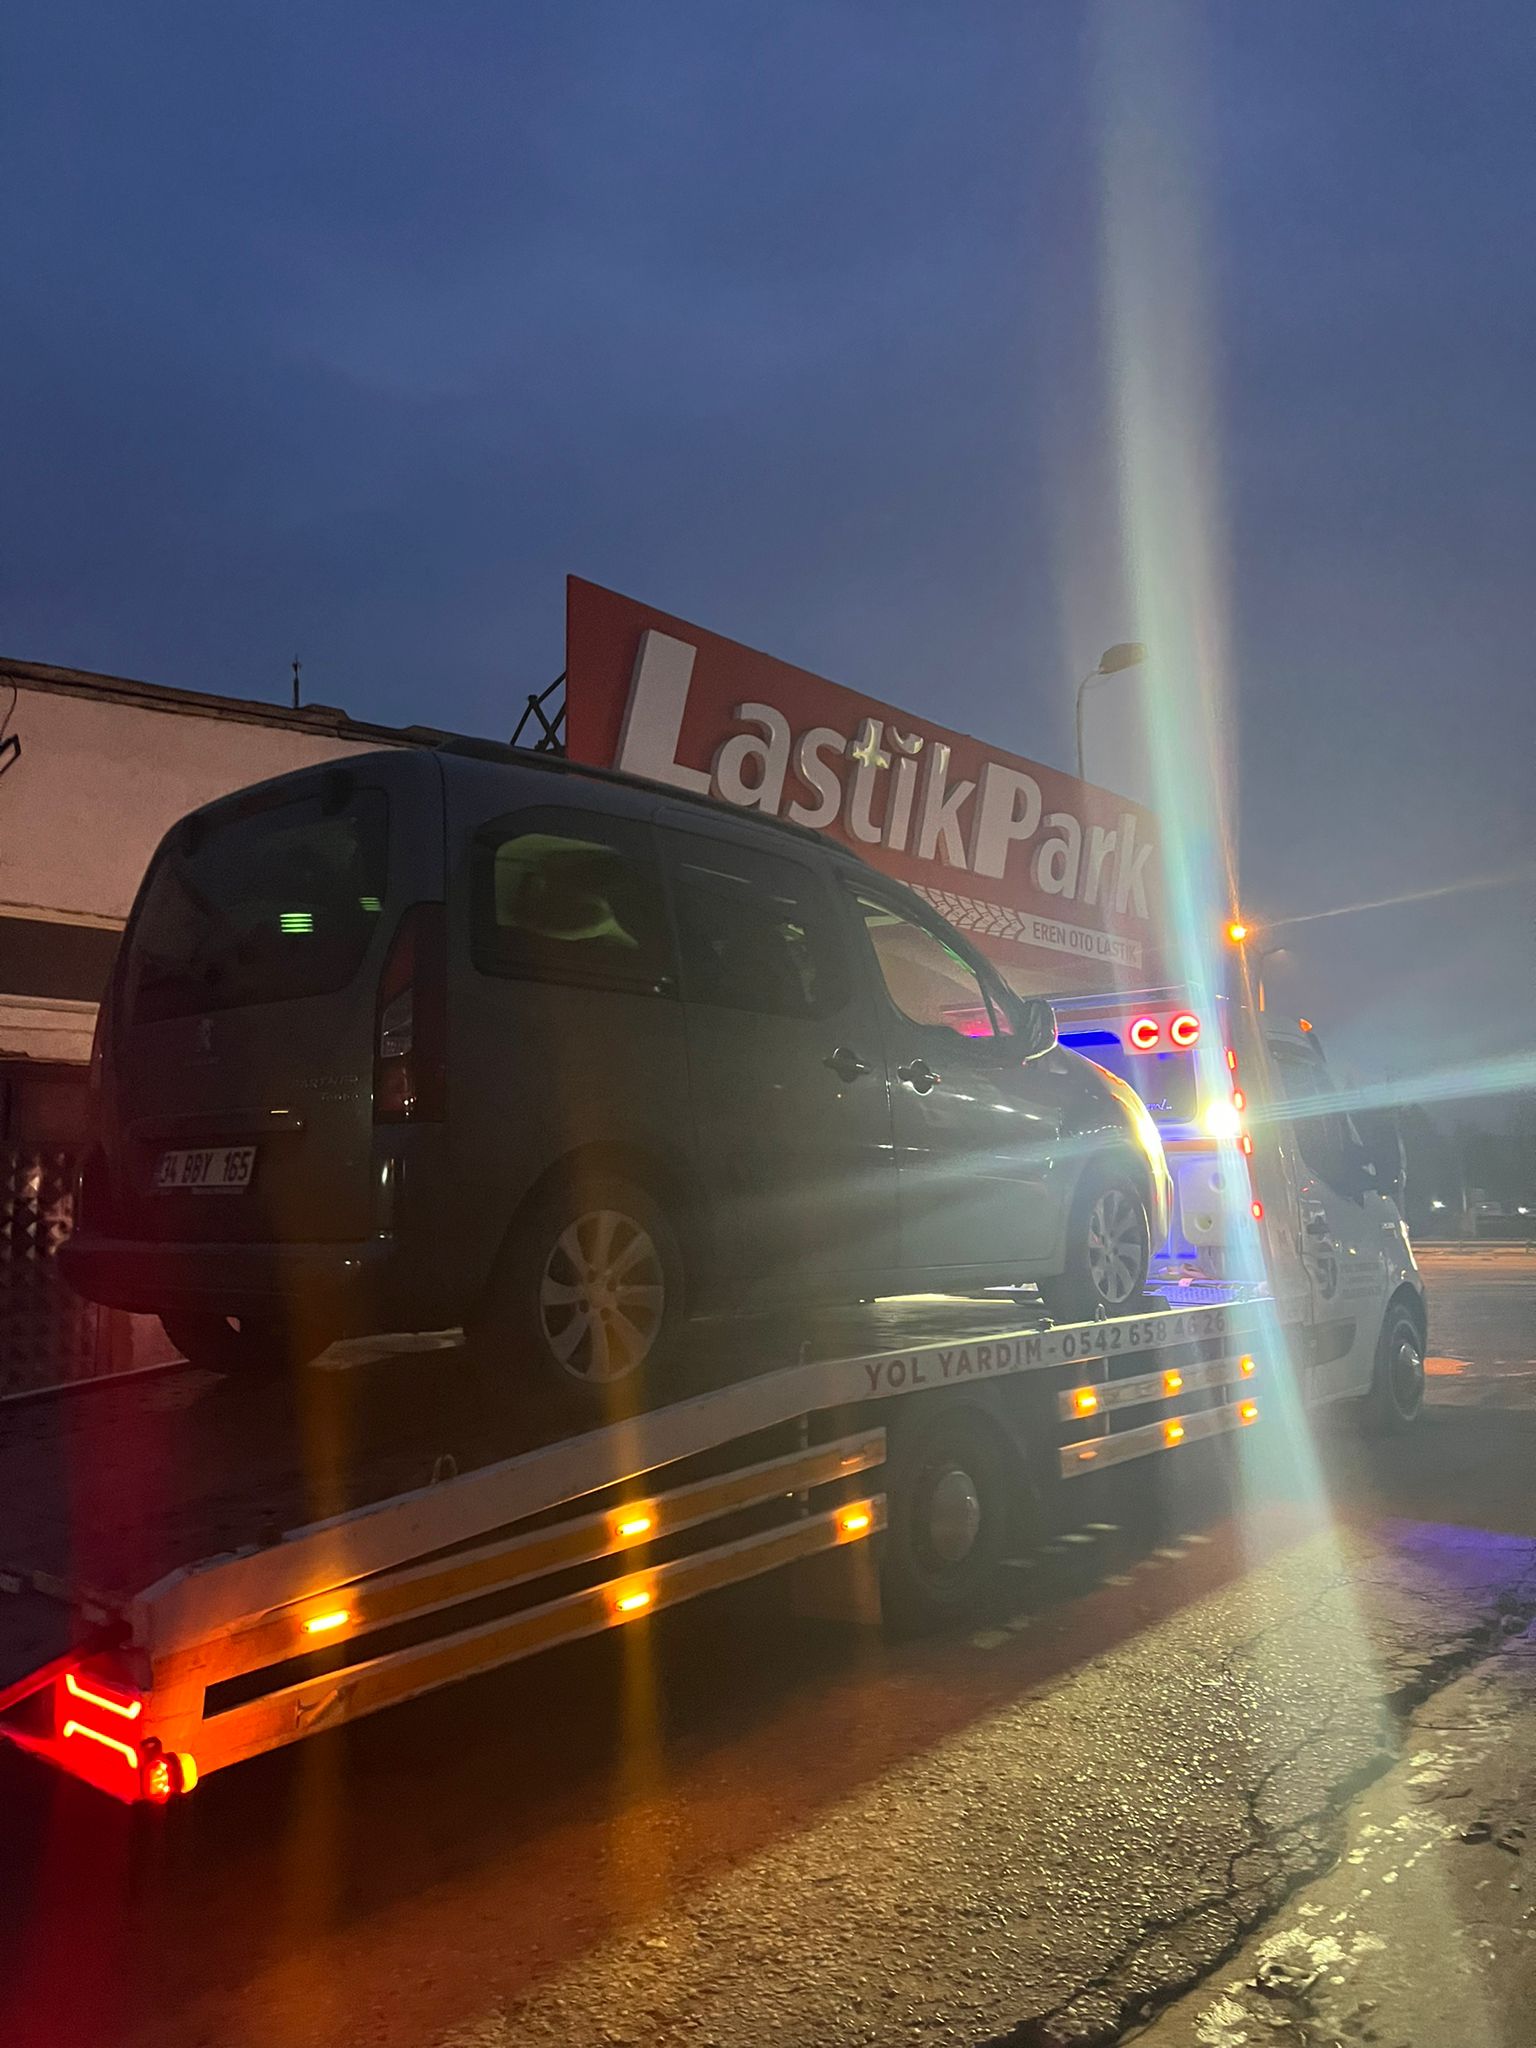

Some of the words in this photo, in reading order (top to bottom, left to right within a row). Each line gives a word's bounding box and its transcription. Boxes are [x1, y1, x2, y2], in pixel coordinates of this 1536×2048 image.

[1032, 921, 1066, 946] EREN
[1069, 930, 1093, 952] OTO
[223, 1151, 253, 1182] 165
[864, 1357, 927, 1391] YOL
[938, 1337, 1043, 1378] YARDIM
[1062, 1326, 1122, 1358] 0542
[1128, 1321, 1167, 1346] 658
[1202, 1310, 1226, 1333] 26
